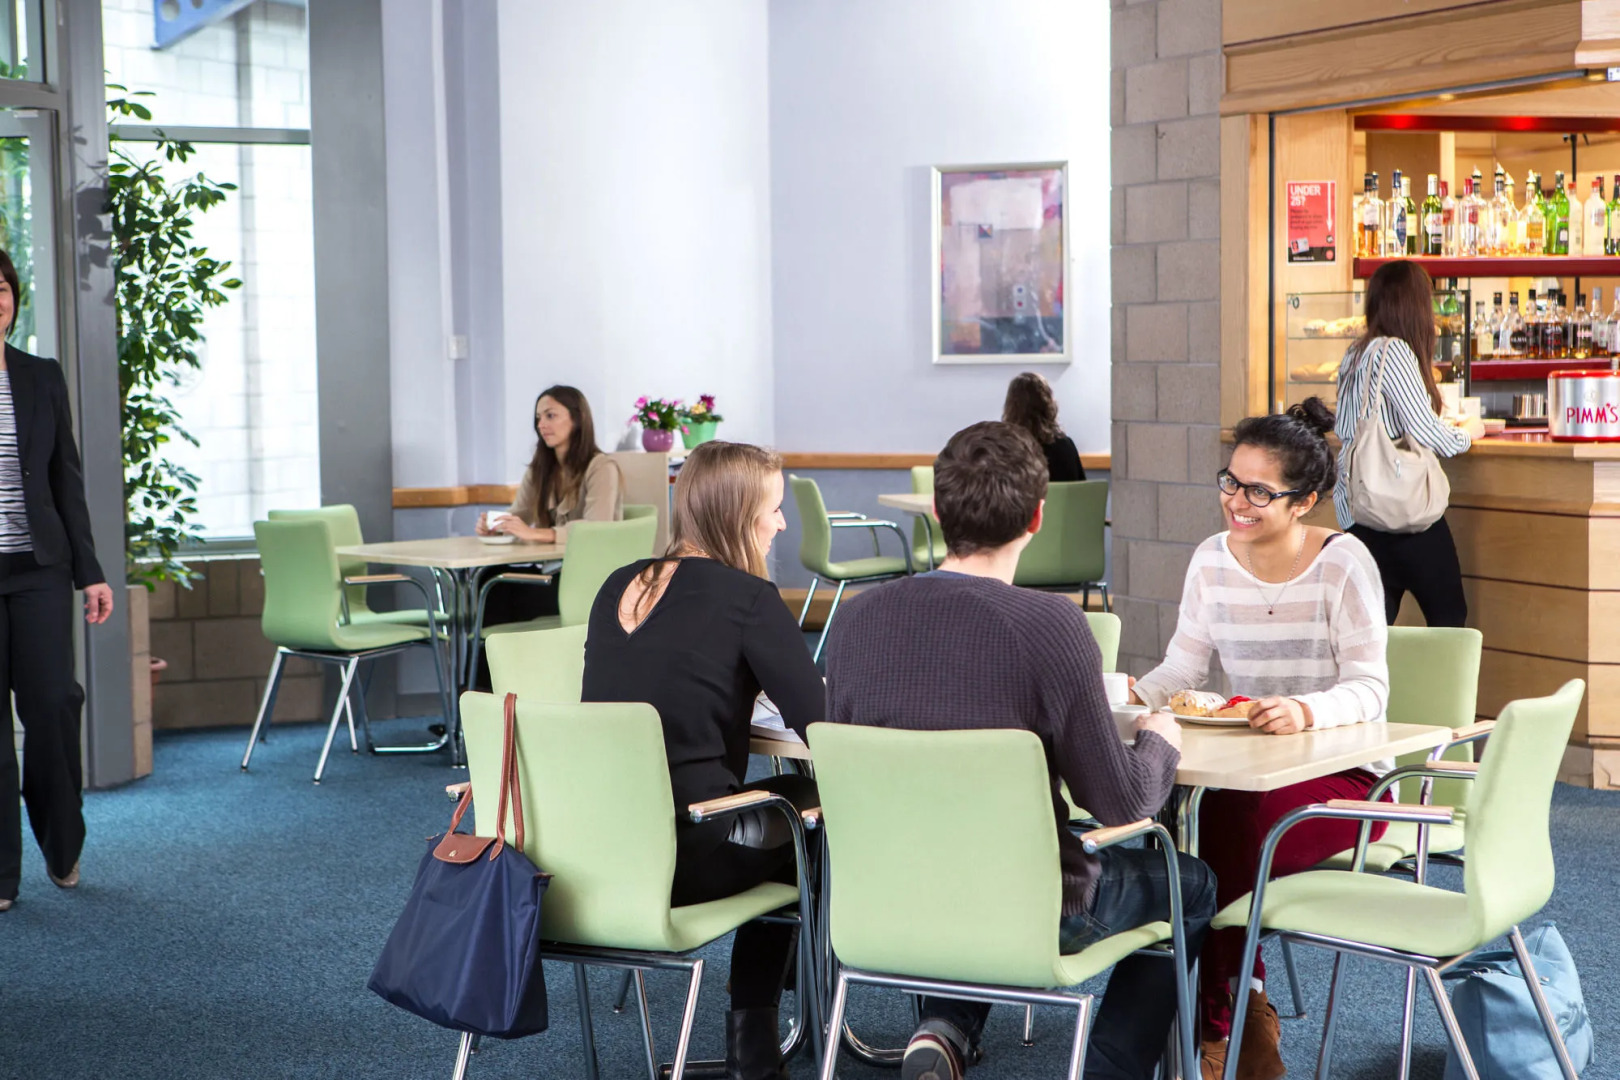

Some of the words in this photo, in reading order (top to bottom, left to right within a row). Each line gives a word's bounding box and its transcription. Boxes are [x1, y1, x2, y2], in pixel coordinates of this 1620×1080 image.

[1290, 185, 1321, 195] UNDER
[1290, 196, 1306, 206] 25?
[1566, 403, 1619, 424] PIMM'S
